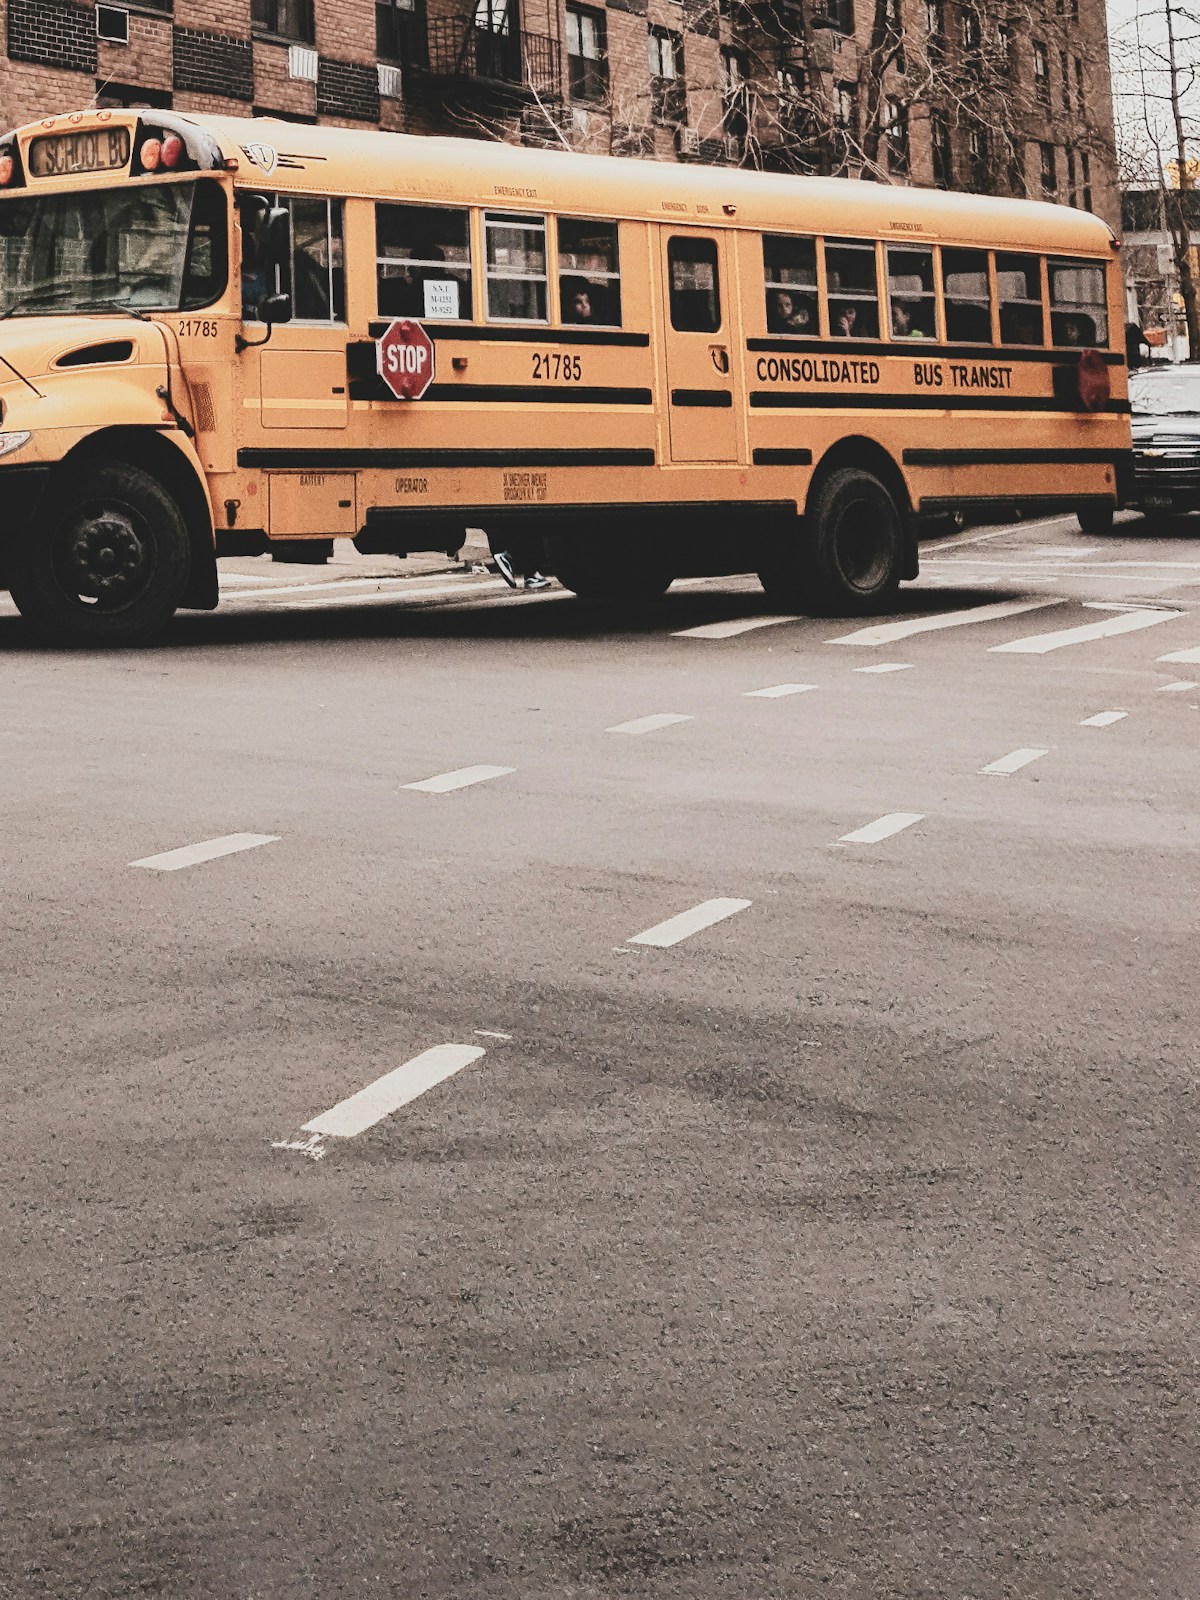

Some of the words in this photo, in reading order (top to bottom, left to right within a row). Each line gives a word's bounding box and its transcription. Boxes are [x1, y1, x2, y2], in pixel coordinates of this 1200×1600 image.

[45, 132, 105, 173] SCHOOL
[179, 320, 218, 338] 21785
[386, 343, 428, 374] STOP
[532, 352, 582, 381] 21785
[756, 357, 881, 384] CONSOLIDATED
[913, 363, 943, 387] BUS
[949, 365, 1013, 389] TRANSIT
[299, 474, 326, 487] BATTERY
[395, 478, 429, 494] OPERATOR
